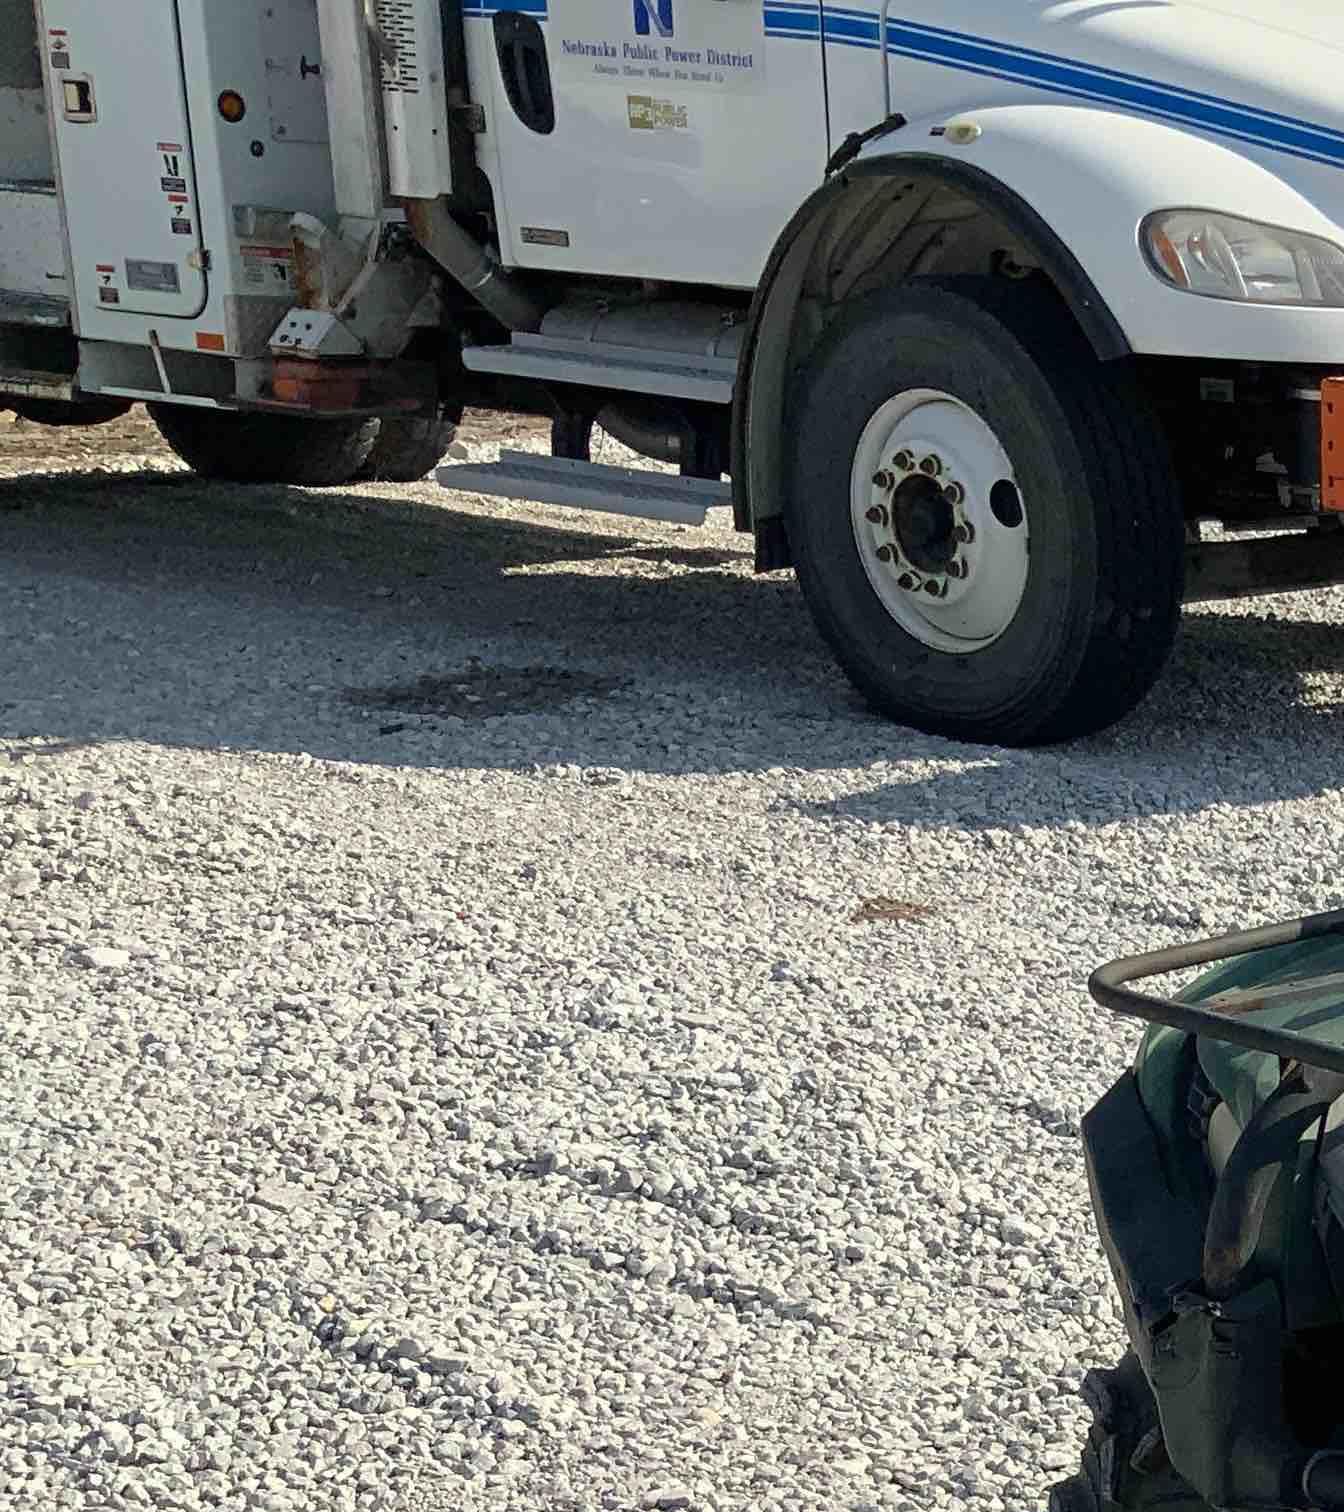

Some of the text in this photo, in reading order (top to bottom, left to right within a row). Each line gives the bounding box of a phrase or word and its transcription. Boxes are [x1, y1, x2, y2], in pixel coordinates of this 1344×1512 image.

[562, 39, 753, 68] Nebraska Public Power District
